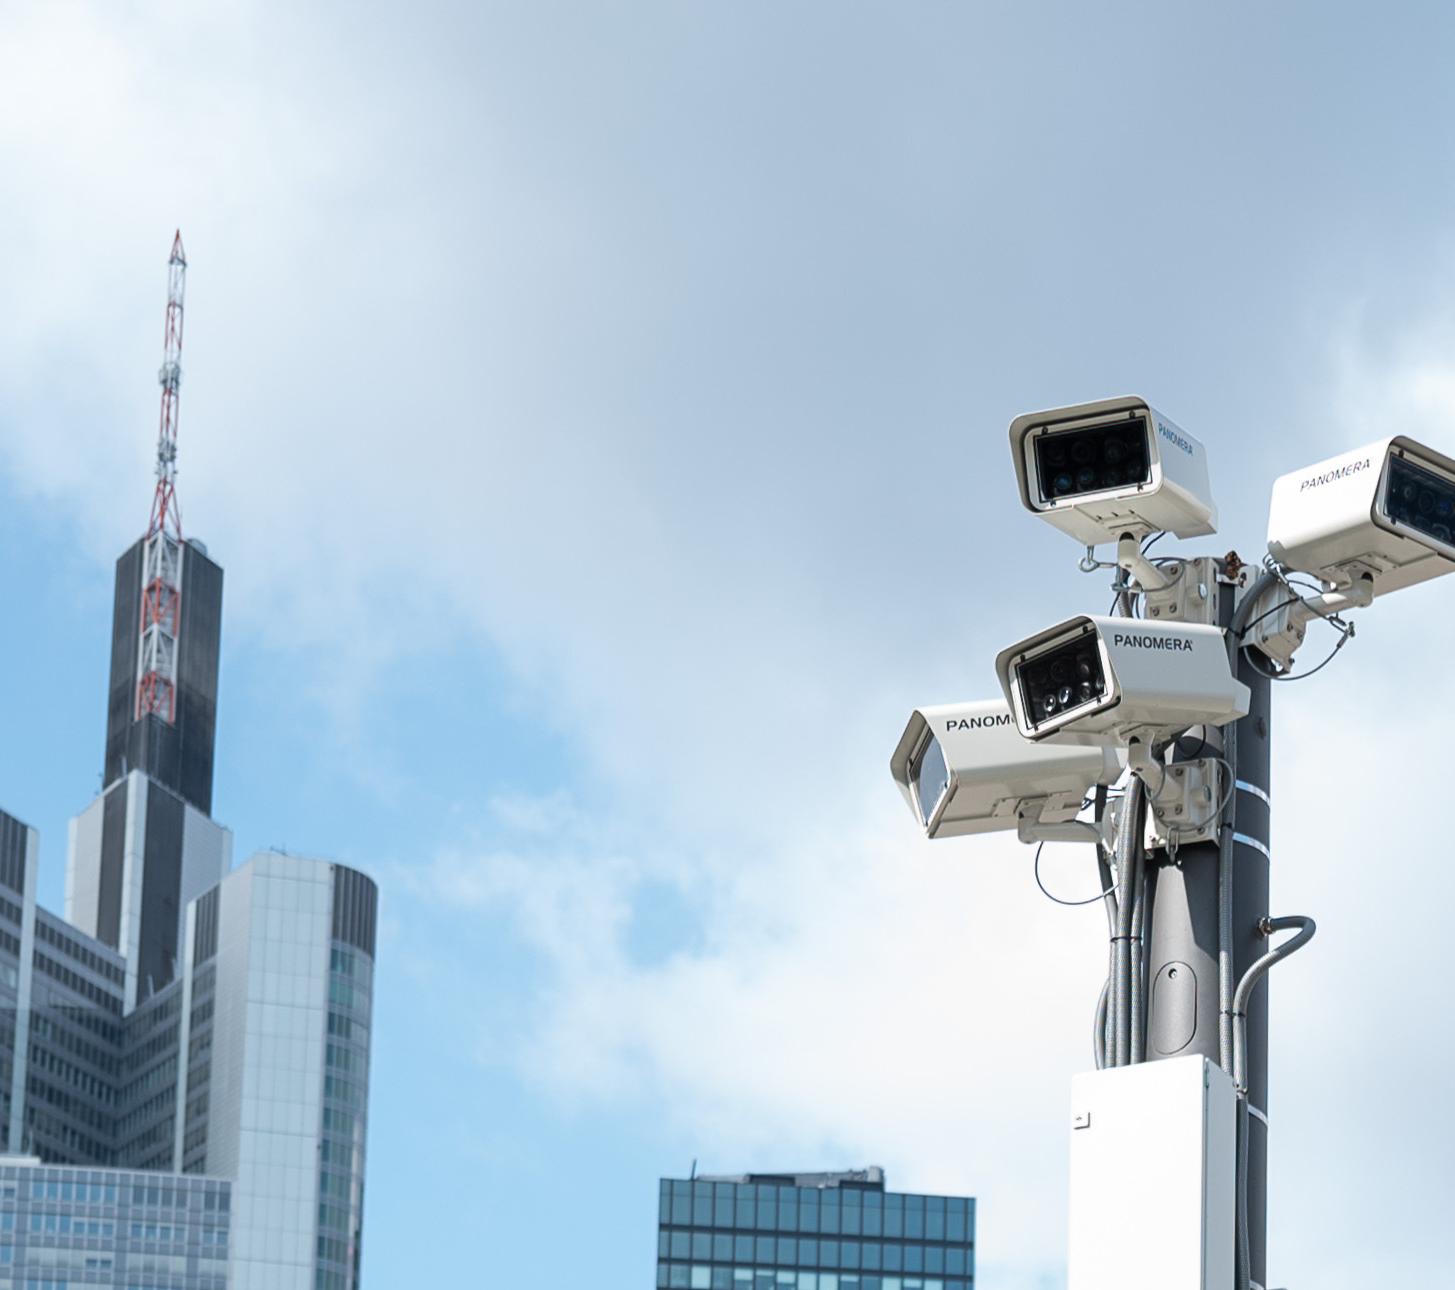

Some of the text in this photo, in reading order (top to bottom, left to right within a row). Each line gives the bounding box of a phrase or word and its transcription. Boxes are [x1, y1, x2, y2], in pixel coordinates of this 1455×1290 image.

[1158, 422, 1194, 456] PANOMERA
[1300, 458, 1371, 492] PANOMERA
[1115, 634, 1191, 651] PANOMERA
[946, 713, 1015, 732] PANOM
